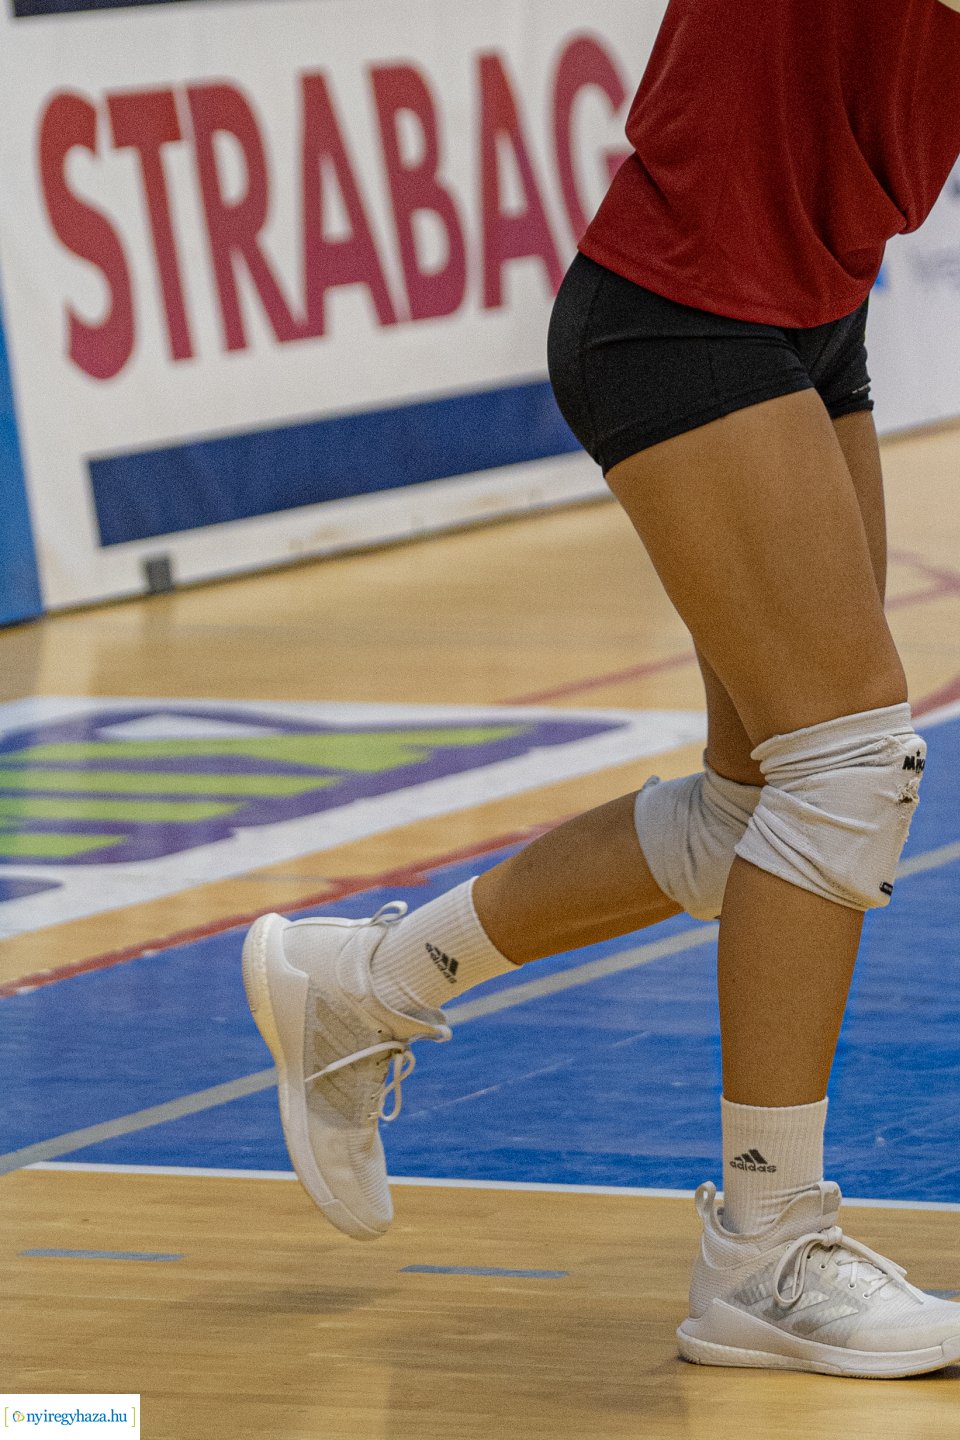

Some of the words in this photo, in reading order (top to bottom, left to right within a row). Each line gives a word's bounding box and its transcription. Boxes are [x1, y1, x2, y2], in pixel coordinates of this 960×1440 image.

[37, 32, 636, 382] STRABAG
[425, 942, 457, 984] adidas
[729, 1160, 777, 1173] adidas
